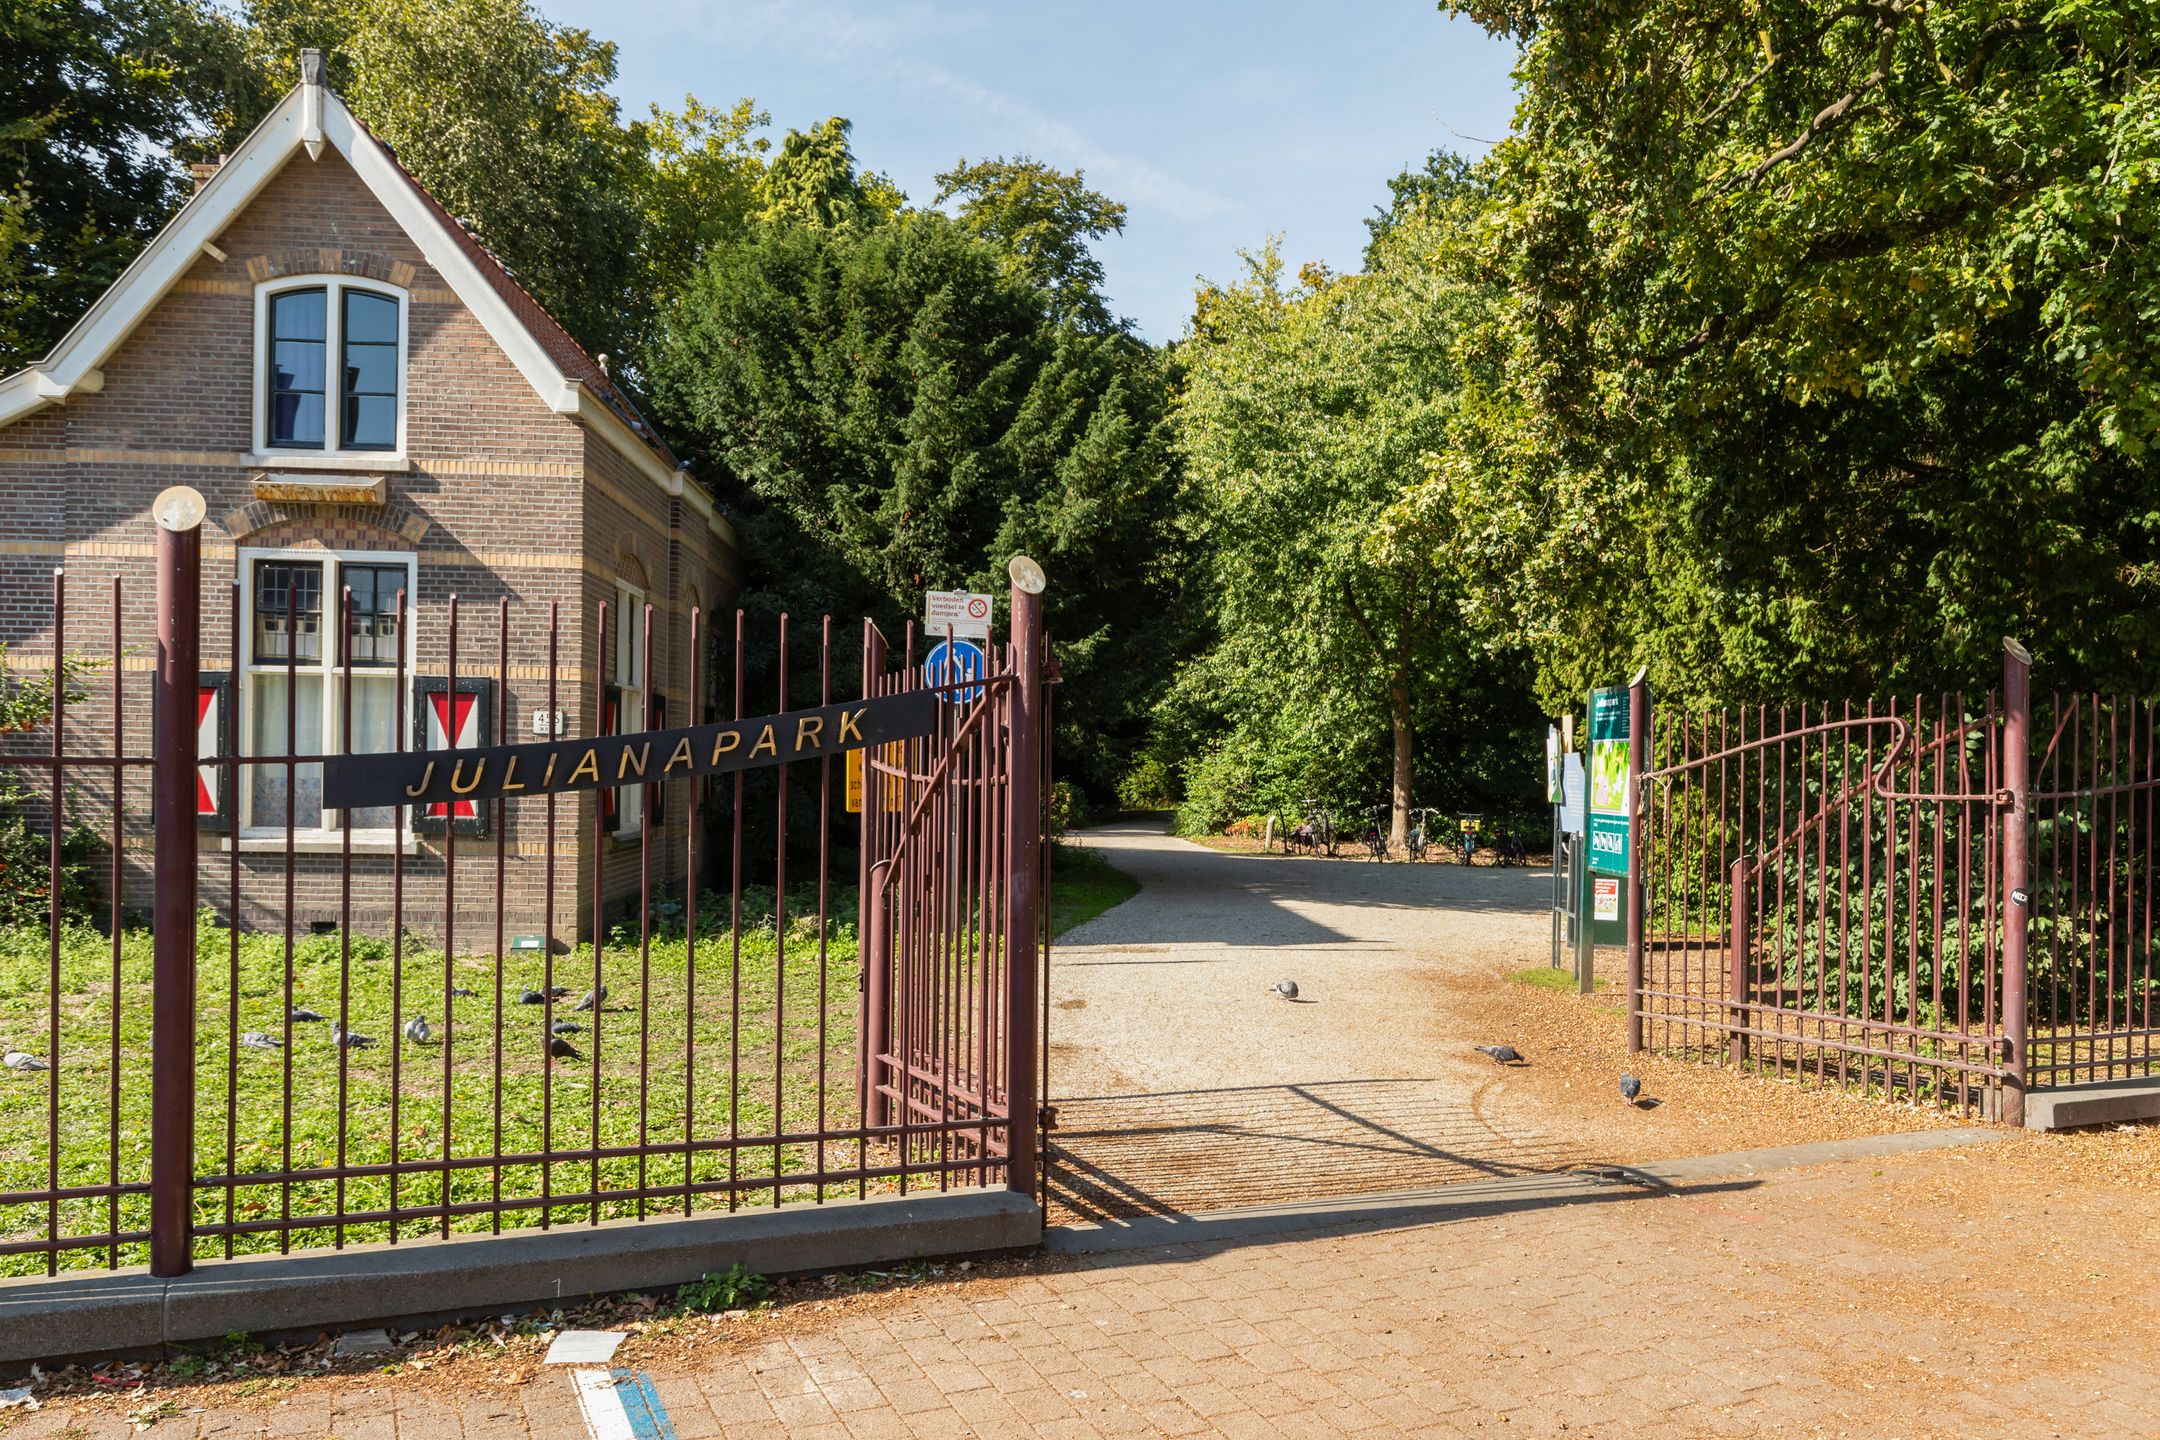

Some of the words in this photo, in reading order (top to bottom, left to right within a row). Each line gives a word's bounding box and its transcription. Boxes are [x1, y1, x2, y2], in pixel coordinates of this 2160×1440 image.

[932, 595, 964, 603] Verboden
[932, 602, 958, 610] voedsel
[406, 707, 869, 798] JULIANAPARK
